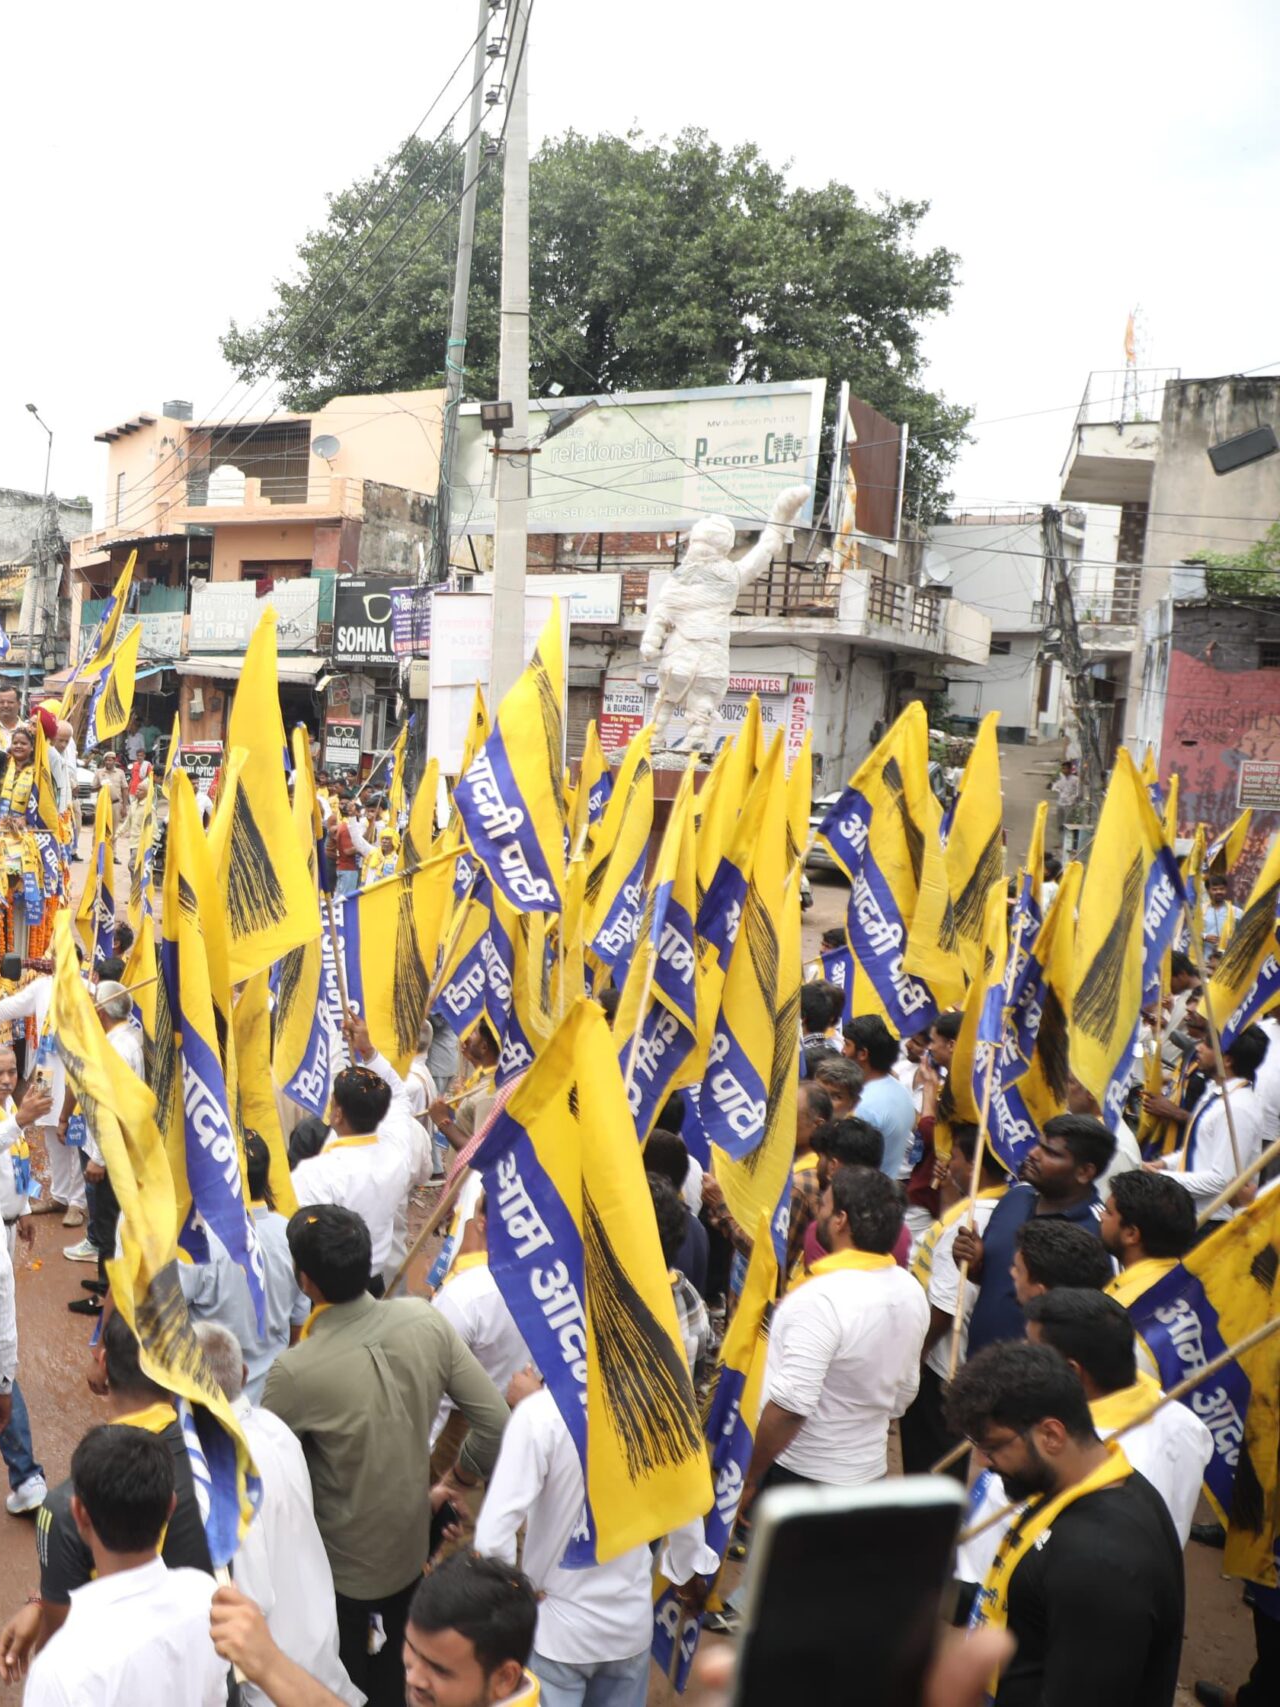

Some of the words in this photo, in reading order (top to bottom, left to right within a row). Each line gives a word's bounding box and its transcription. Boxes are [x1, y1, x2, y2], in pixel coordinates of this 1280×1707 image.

[551, 438, 677, 464] relationships
[562, 508, 583, 518] SBI
[599, 506, 634, 517] HDFC
[639, 504, 671, 516] Bank
[337, 626, 387, 652] SOHNA
[371, 654, 399, 662] SPECTACLE
[728, 677, 780, 692] SSOCIATES
[624, 695, 644, 704] PIZZA
[613, 703, 640, 713] BURGER
[327, 736, 341, 746] SOHNA
[342, 737, 360, 748] OPTICAL
[196, 766, 216, 777] OPTICA
[499, 841, 555, 903] पार्टी
[711, 1068, 767, 1141] पार्टी
[496, 1150, 555, 1260] आम
